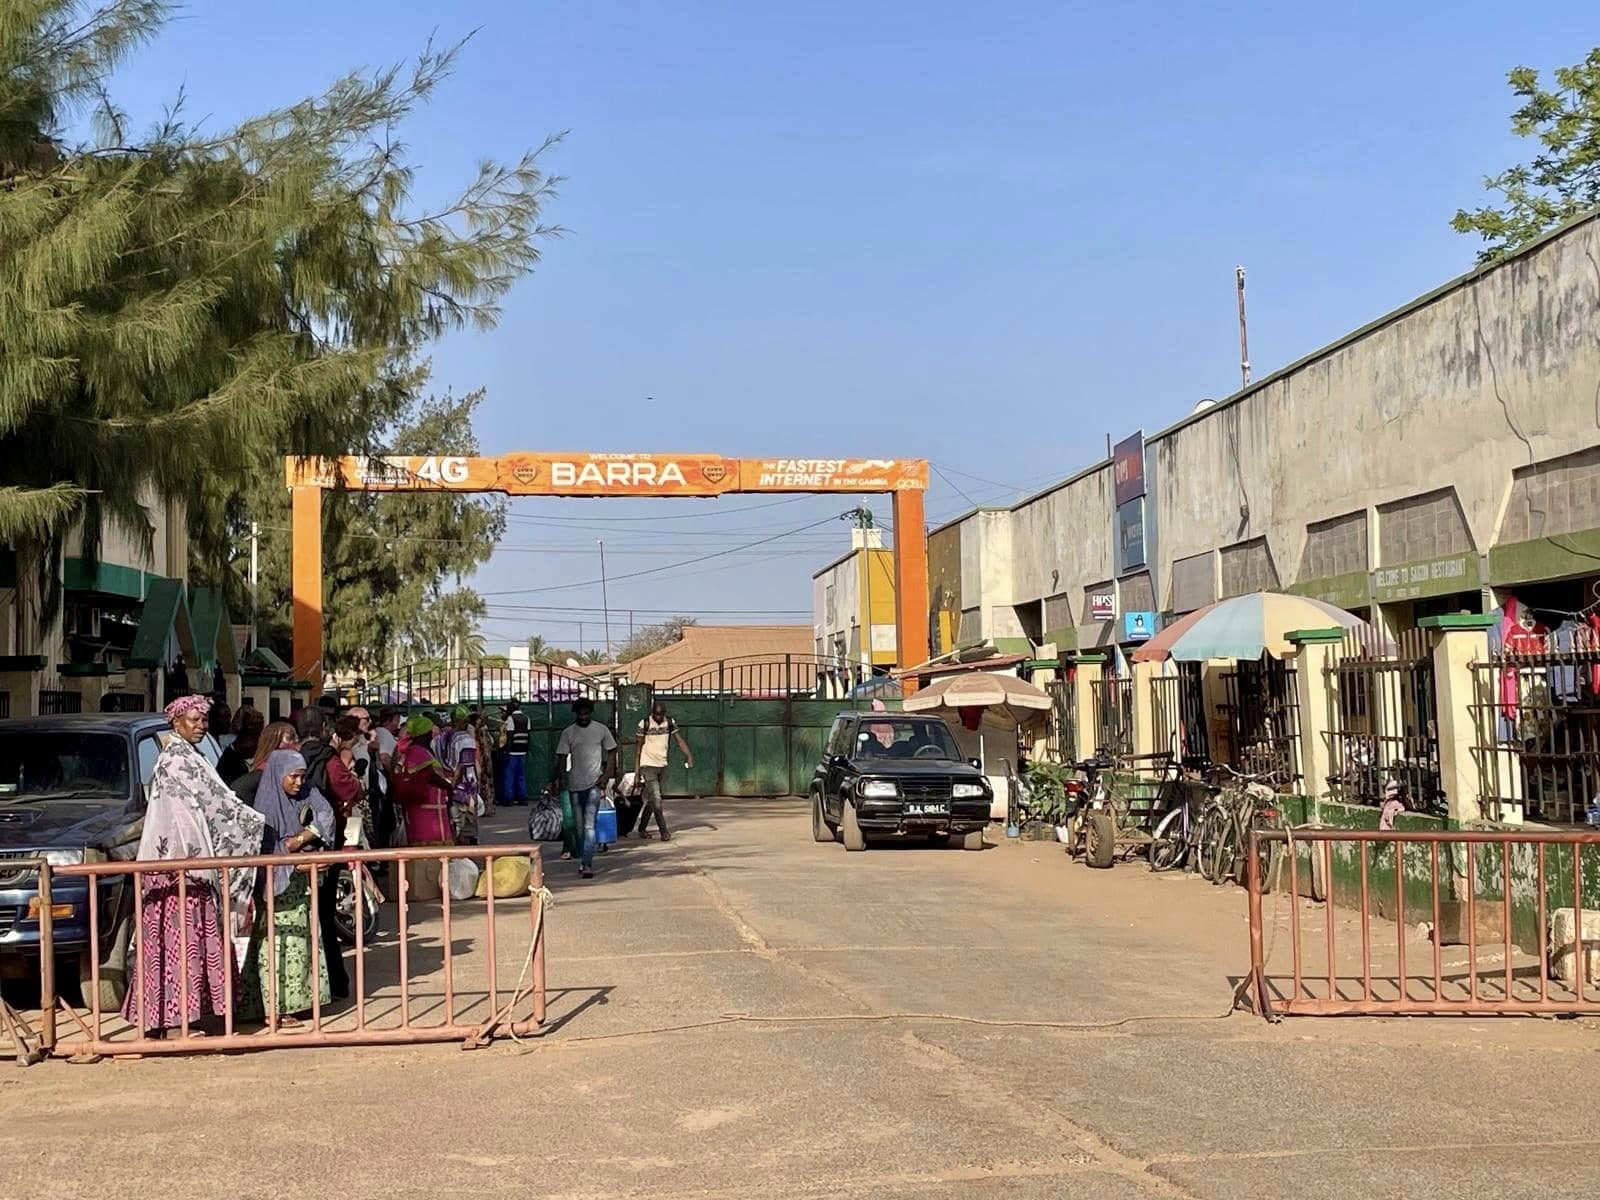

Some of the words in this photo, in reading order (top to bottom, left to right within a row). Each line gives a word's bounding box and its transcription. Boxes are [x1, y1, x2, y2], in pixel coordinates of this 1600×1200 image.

[417, 456, 468, 484] 4G
[551, 463, 687, 486] BARRA
[777, 460, 847, 473] FASTEST
[760, 473, 832, 486] INTERNET
[1431, 558, 1466, 579] RESTAURANT
